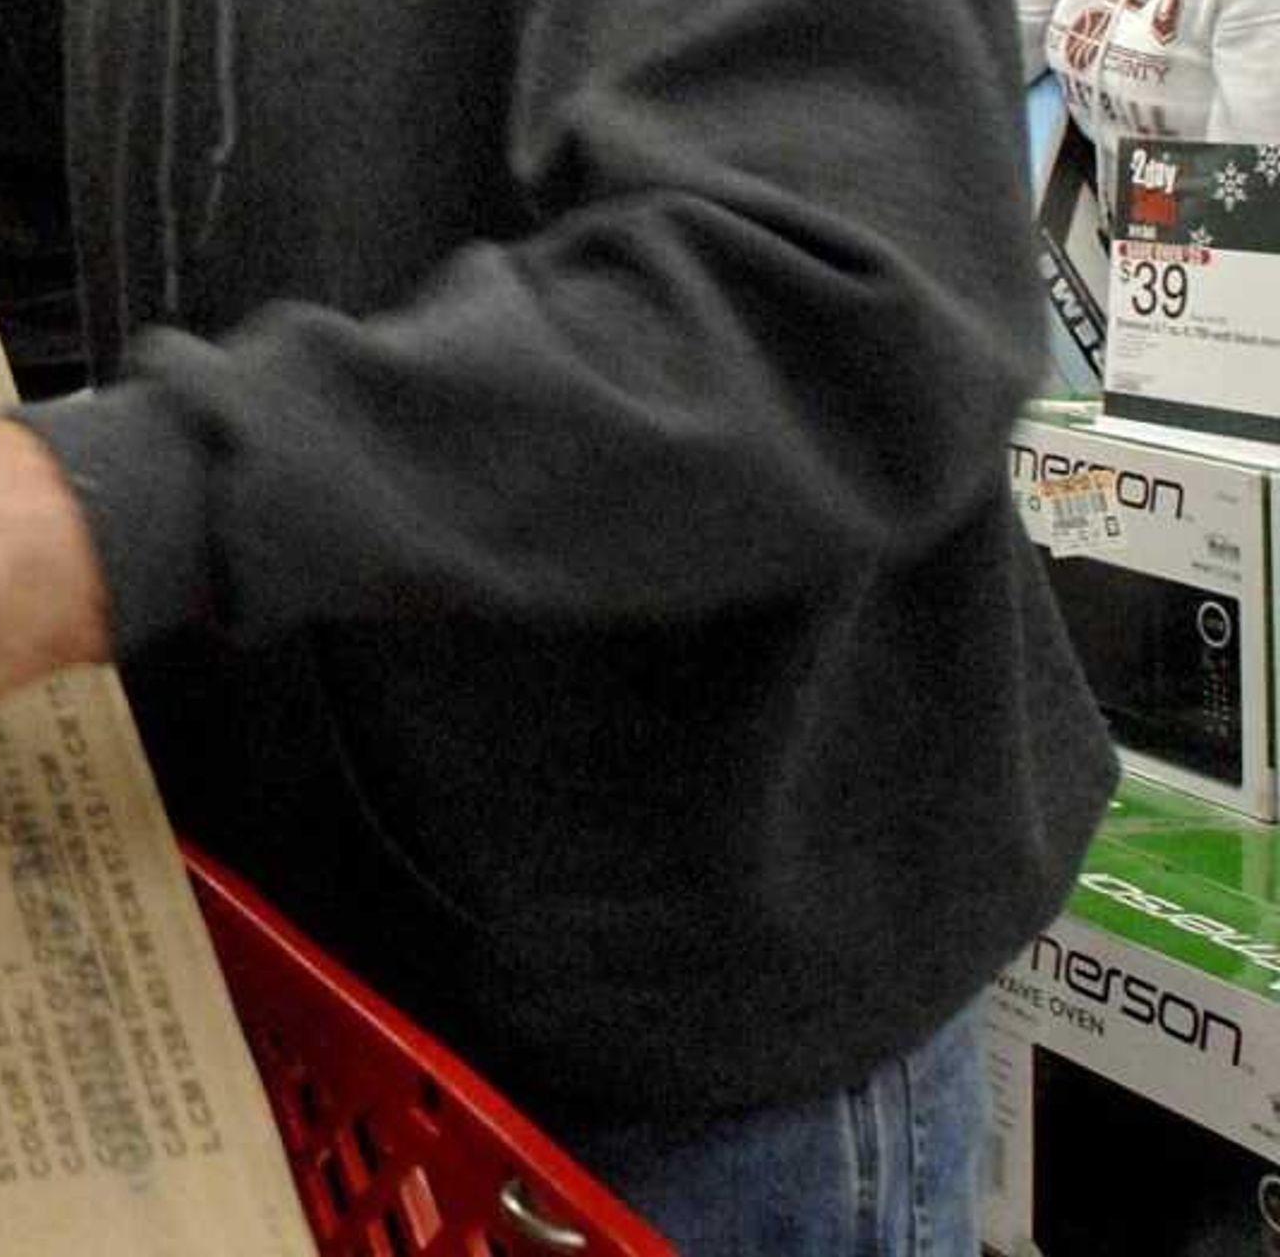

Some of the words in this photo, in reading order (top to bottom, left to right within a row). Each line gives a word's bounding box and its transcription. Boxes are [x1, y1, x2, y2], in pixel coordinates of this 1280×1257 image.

[1119, 258, 1188, 320] $39
[31, 750, 68, 798] CM
[59, 833, 142, 1022] DIMENSIONS
[1049, 996, 1104, 1038] OVEN
[13, 1001, 86, 1176] CASEPACK
[124, 1026, 187, 1160] CARTON
[175, 1076, 213, 1130] CM
